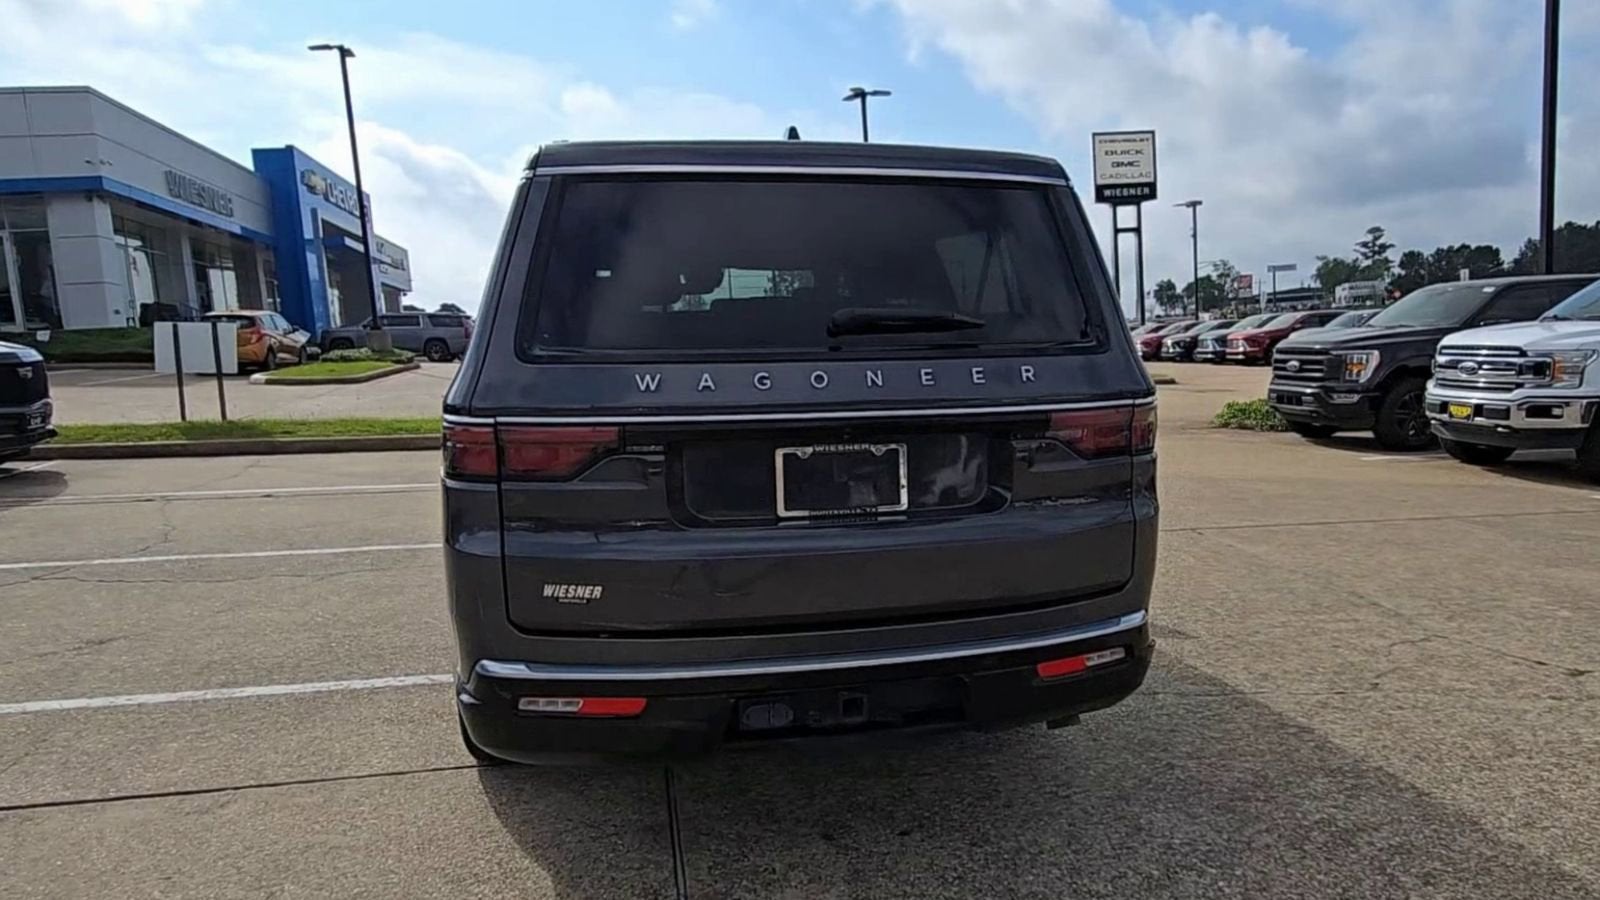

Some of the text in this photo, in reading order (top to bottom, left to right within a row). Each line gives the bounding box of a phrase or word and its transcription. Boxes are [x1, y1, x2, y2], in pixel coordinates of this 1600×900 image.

[1100, 171, 1152, 180] CADILLAC
[164, 169, 234, 217] WIESNER
[1103, 187, 1150, 197] WIESNER
[635, 365, 1036, 392] WAGONEER
[814, 443, 871, 453] WIESNER
[543, 584, 602, 599] WIESNER
